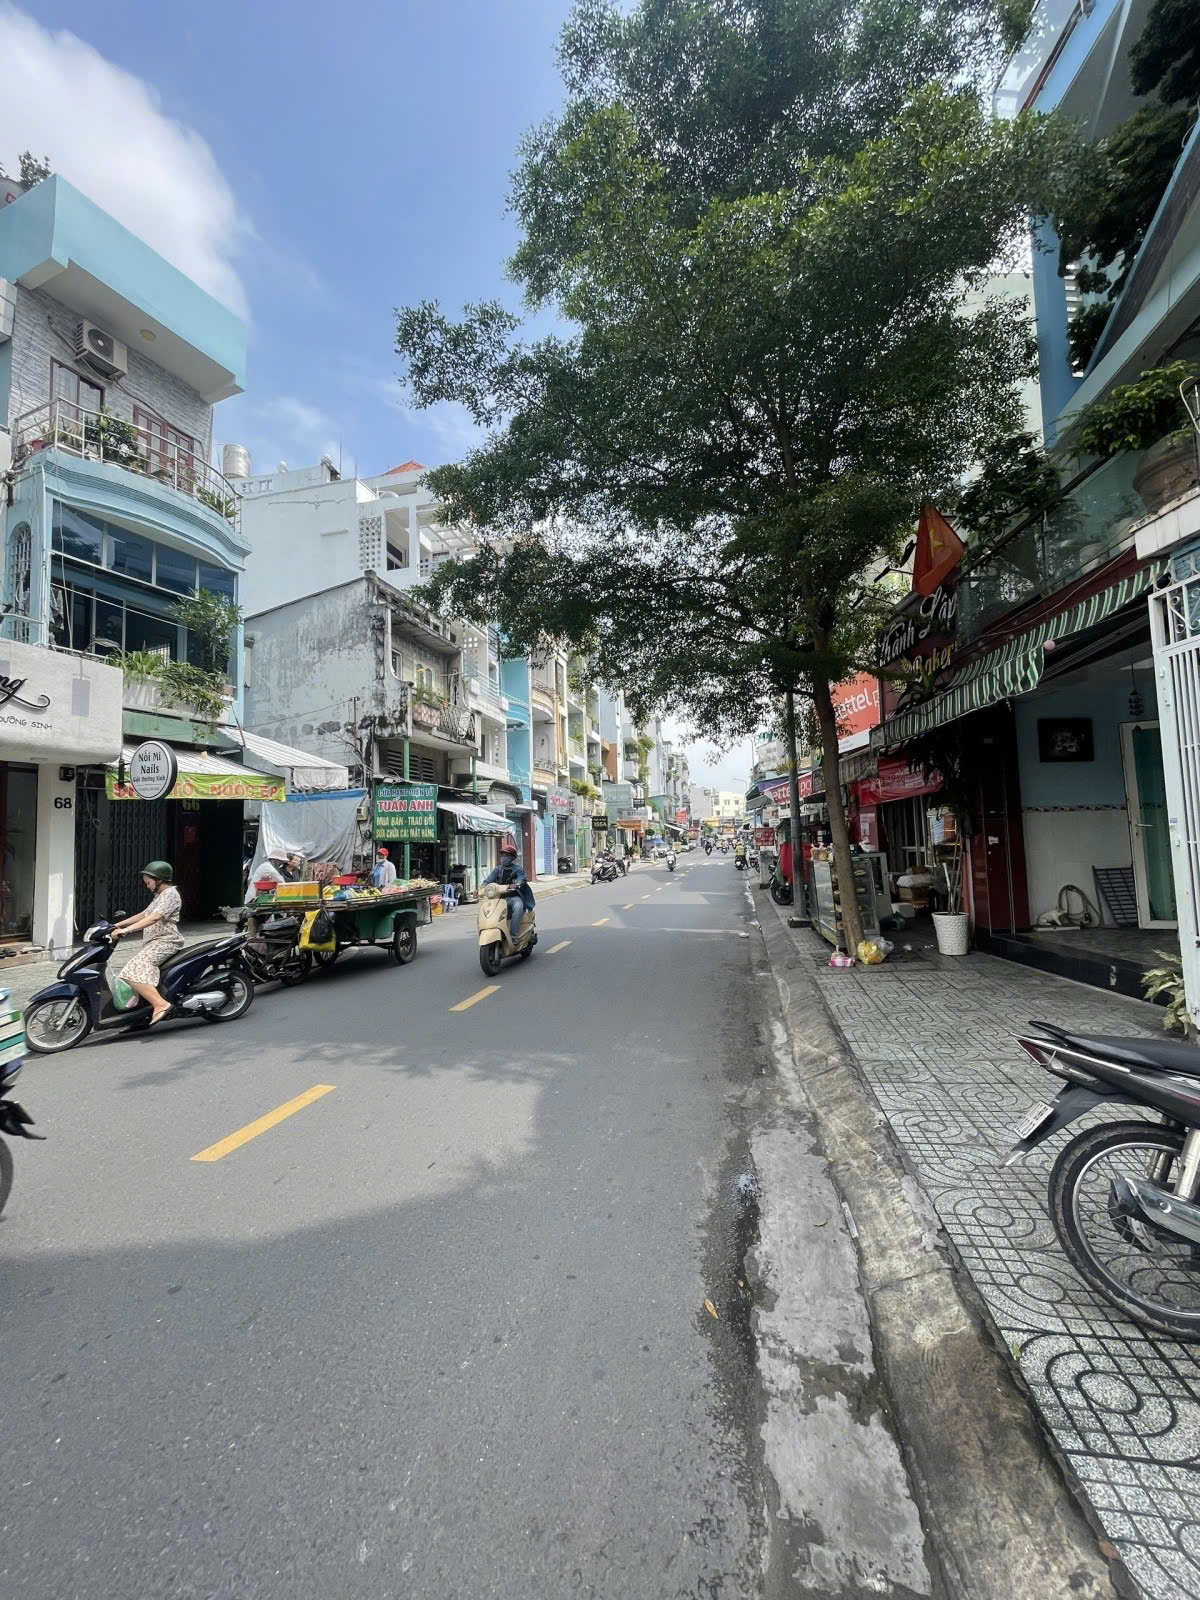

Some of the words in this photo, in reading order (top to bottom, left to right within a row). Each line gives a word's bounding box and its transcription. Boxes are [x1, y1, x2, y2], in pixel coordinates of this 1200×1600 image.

[31, 721, 52, 730] SINH
[153, 752, 161, 761] Mi
[141, 764, 160, 774] Nails
[54, 797, 72, 809] 68
[377, 797, 407, 812] TUẤN
[409, 800, 434, 811] ANH
[377, 816, 389, 825] MUA
[391, 815, 403, 825] BÁN
[408, 816, 422, 825] TRAO
